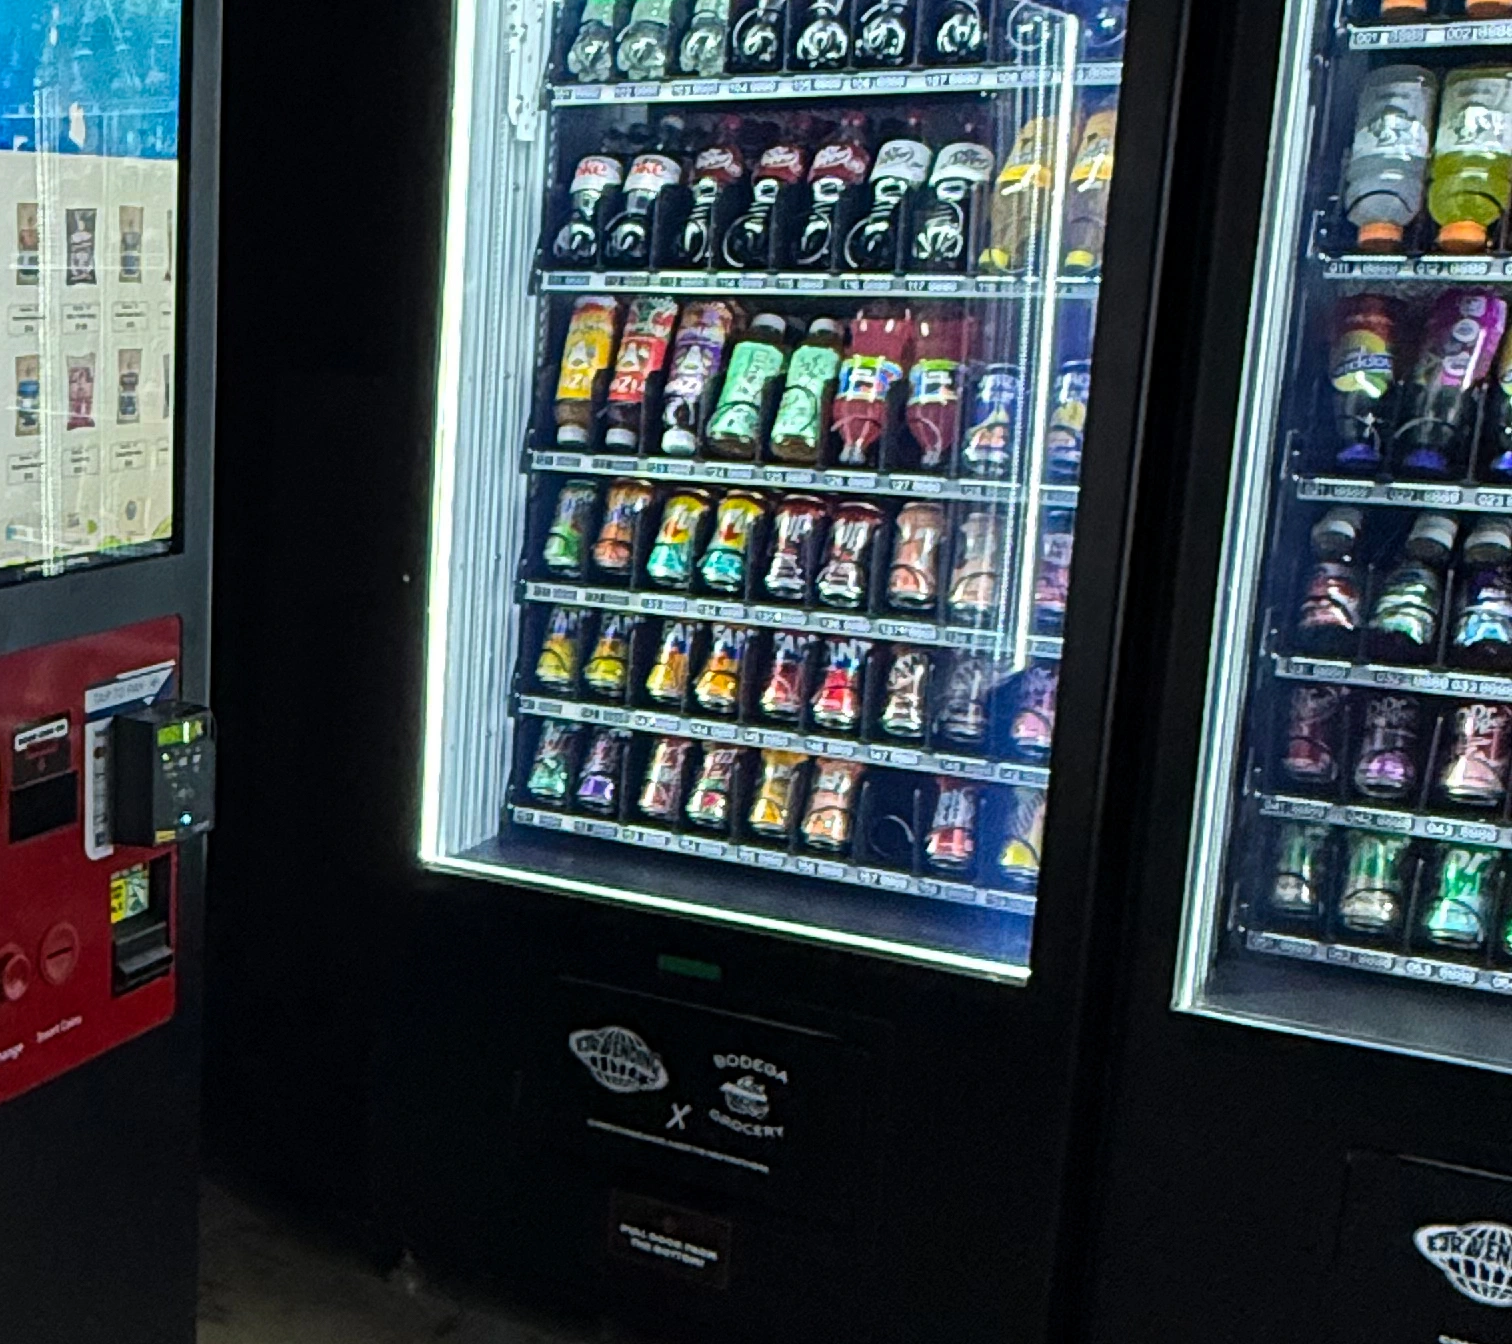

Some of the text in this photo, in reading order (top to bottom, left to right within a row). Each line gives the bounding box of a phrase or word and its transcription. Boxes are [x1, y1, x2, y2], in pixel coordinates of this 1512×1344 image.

[713, 1053, 790, 1085] BODEGA
[665, 1102, 692, 1131] X
[708, 1107, 785, 1138] GROCERY
